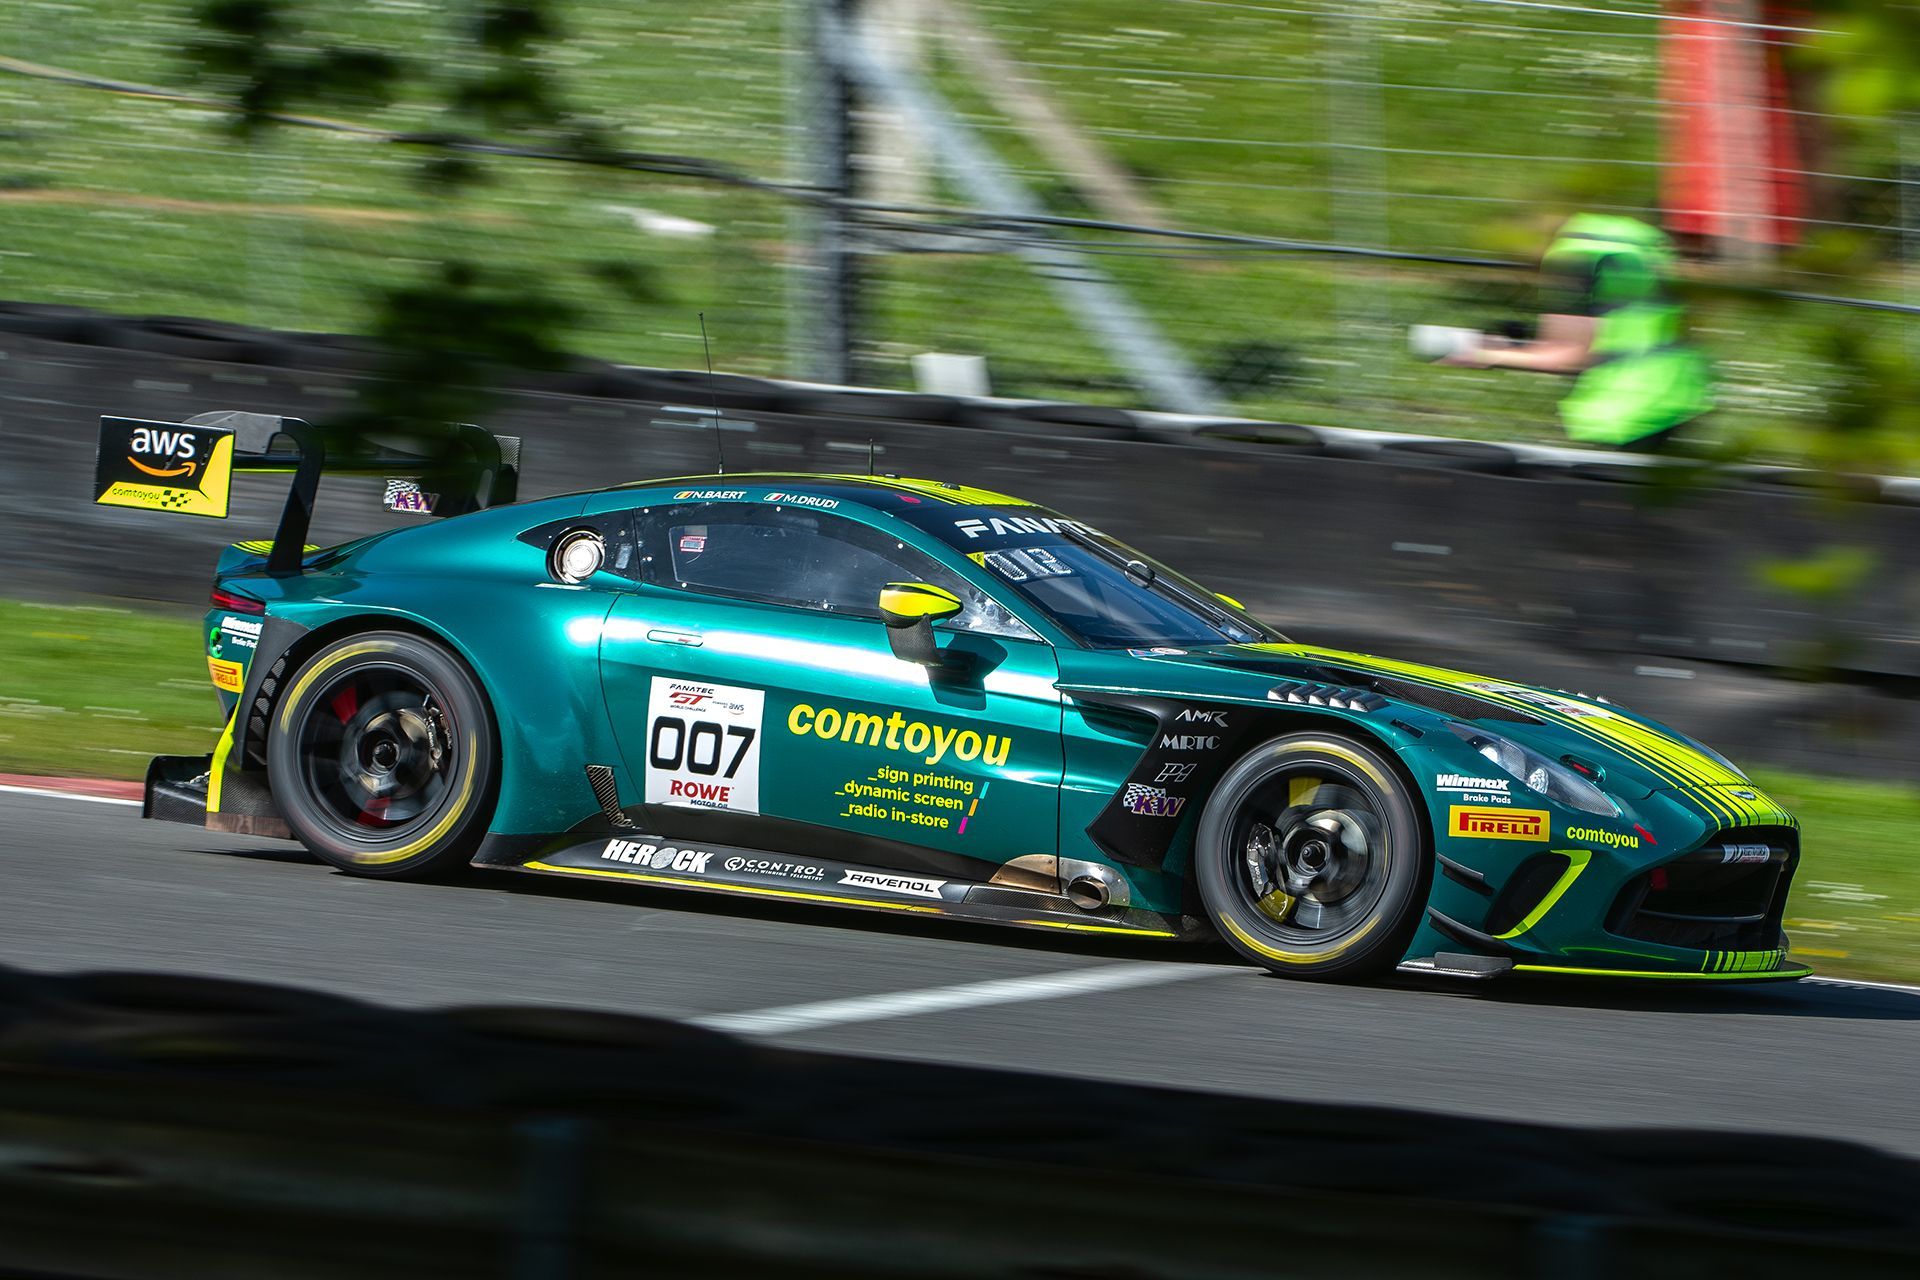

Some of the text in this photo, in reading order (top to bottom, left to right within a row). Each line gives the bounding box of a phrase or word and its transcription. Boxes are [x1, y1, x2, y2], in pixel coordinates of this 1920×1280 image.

[131, 428, 196, 458] aws
[693, 490, 747, 500] N.BAERT
[782, 494, 840, 509] M.DRUDI
[669, 683, 715, 695] FANATEC
[1175, 709, 1228, 728] AMR
[787, 703, 1012, 767] comtoyou
[1159, 733, 1221, 751] MRTC
[650, 715, 757, 779] 007
[670, 779, 730, 802] ROWE
[913, 772, 974, 795] printing
[1437, 773, 1510, 791] Winmax
[913, 792, 964, 810] screen
[1131, 795, 1186, 817] KW
[1463, 793, 1511, 804] Brake Pads
[891, 806, 949, 829] in-store
[1459, 812, 1542, 836] PIRELLI
[1566, 826, 1639, 848] comtoyou
[746, 859, 825, 877] CONTROL
[760, 869, 787, 877] WINNING
[850, 873, 934, 893] RAVENOL
